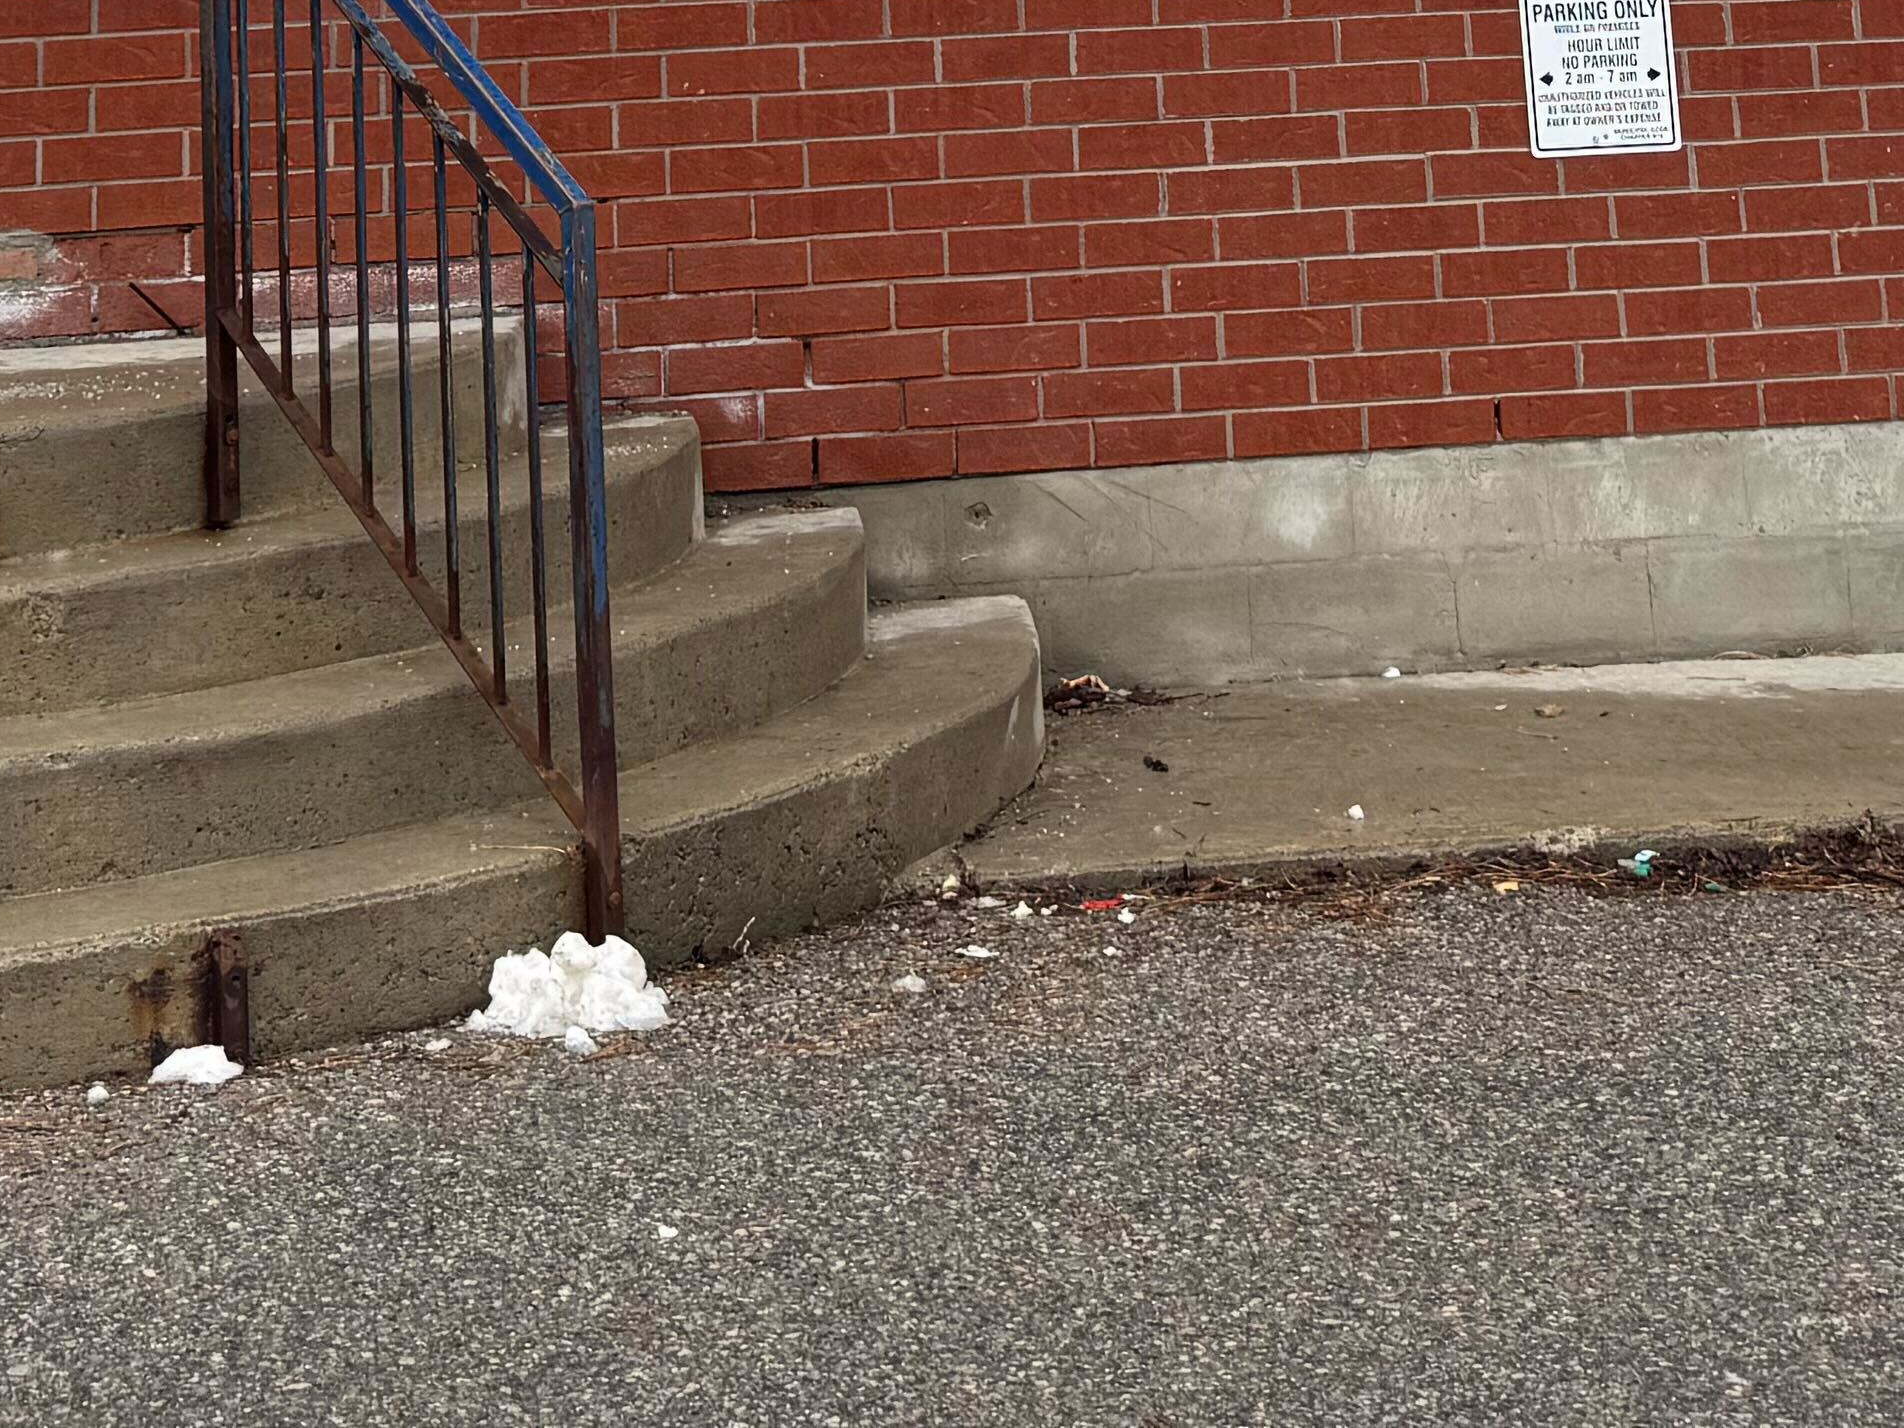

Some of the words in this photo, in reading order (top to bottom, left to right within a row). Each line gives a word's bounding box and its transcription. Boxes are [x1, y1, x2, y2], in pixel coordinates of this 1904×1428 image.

[1532, 0, 1608, 23] PARKING
[1567, 37, 1603, 53] HOUR
[1606, 36, 1641, 52] LIMIT
[1561, 54, 1579, 70] NO
[1583, 53, 1638, 69] PARKING
[1565, 71, 1572, 85] 2
[1576, 72, 1595, 85] am
[1607, 69, 1614, 83] 7
[1619, 70, 1638, 83] am
